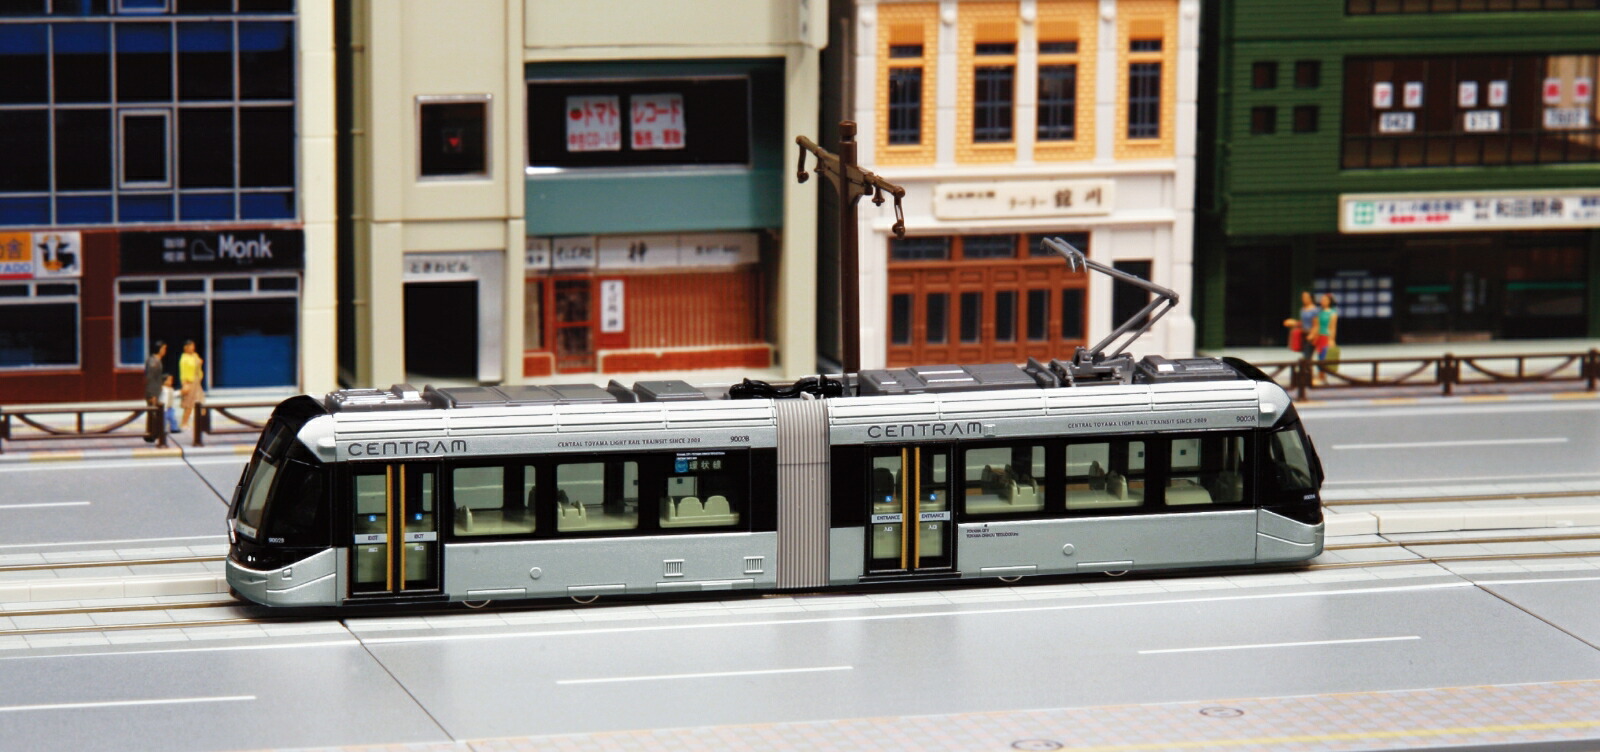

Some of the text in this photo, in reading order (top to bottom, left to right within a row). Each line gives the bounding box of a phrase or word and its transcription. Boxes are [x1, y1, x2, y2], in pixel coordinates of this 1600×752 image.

[584, 100, 618, 127] トマト
[633, 98, 680, 124] レコード
[218, 233, 273, 259] Monk
[410, 261, 469, 274] ときわビル
[868, 421, 982, 438] CENTRAM
[348, 440, 467, 456] CENTRAM
[689, 460, 721, 470] 環状線
